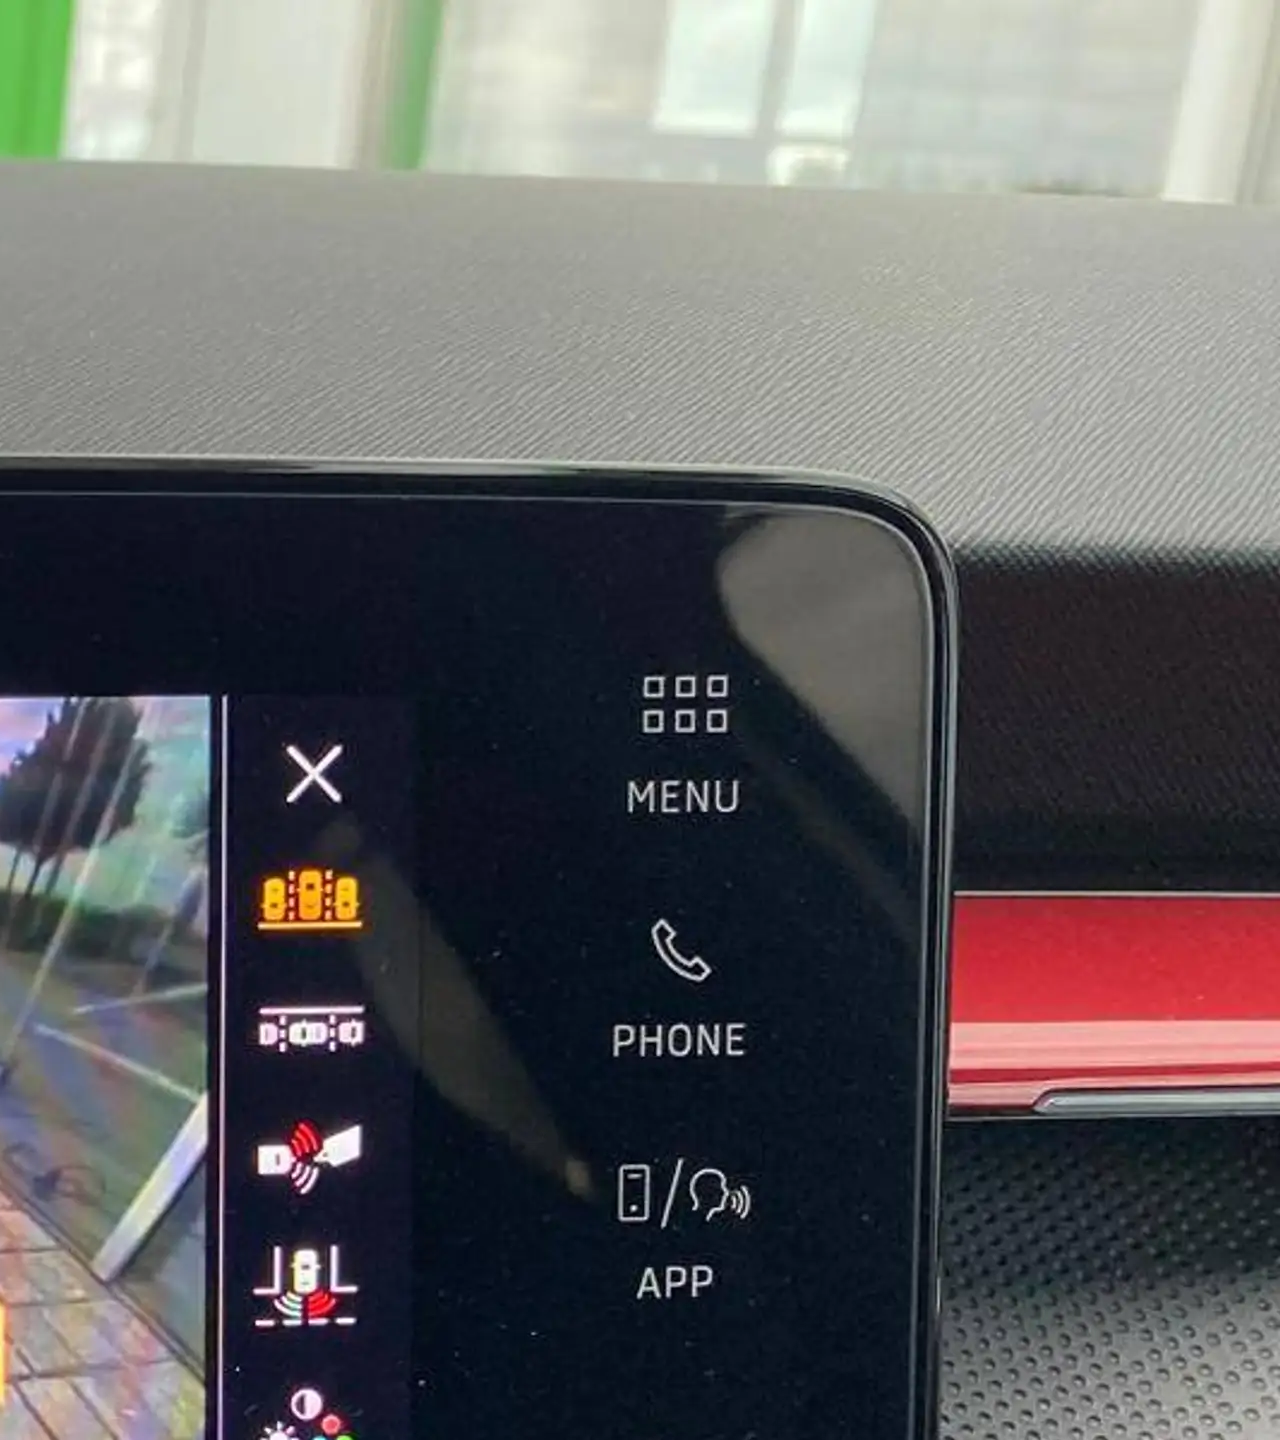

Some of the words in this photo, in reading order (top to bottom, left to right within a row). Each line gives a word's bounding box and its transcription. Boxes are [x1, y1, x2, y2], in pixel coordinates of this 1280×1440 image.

[625, 779, 741, 815] MENU
[610, 1021, 747, 1059] PHONE
[633, 1264, 716, 1300] APP
